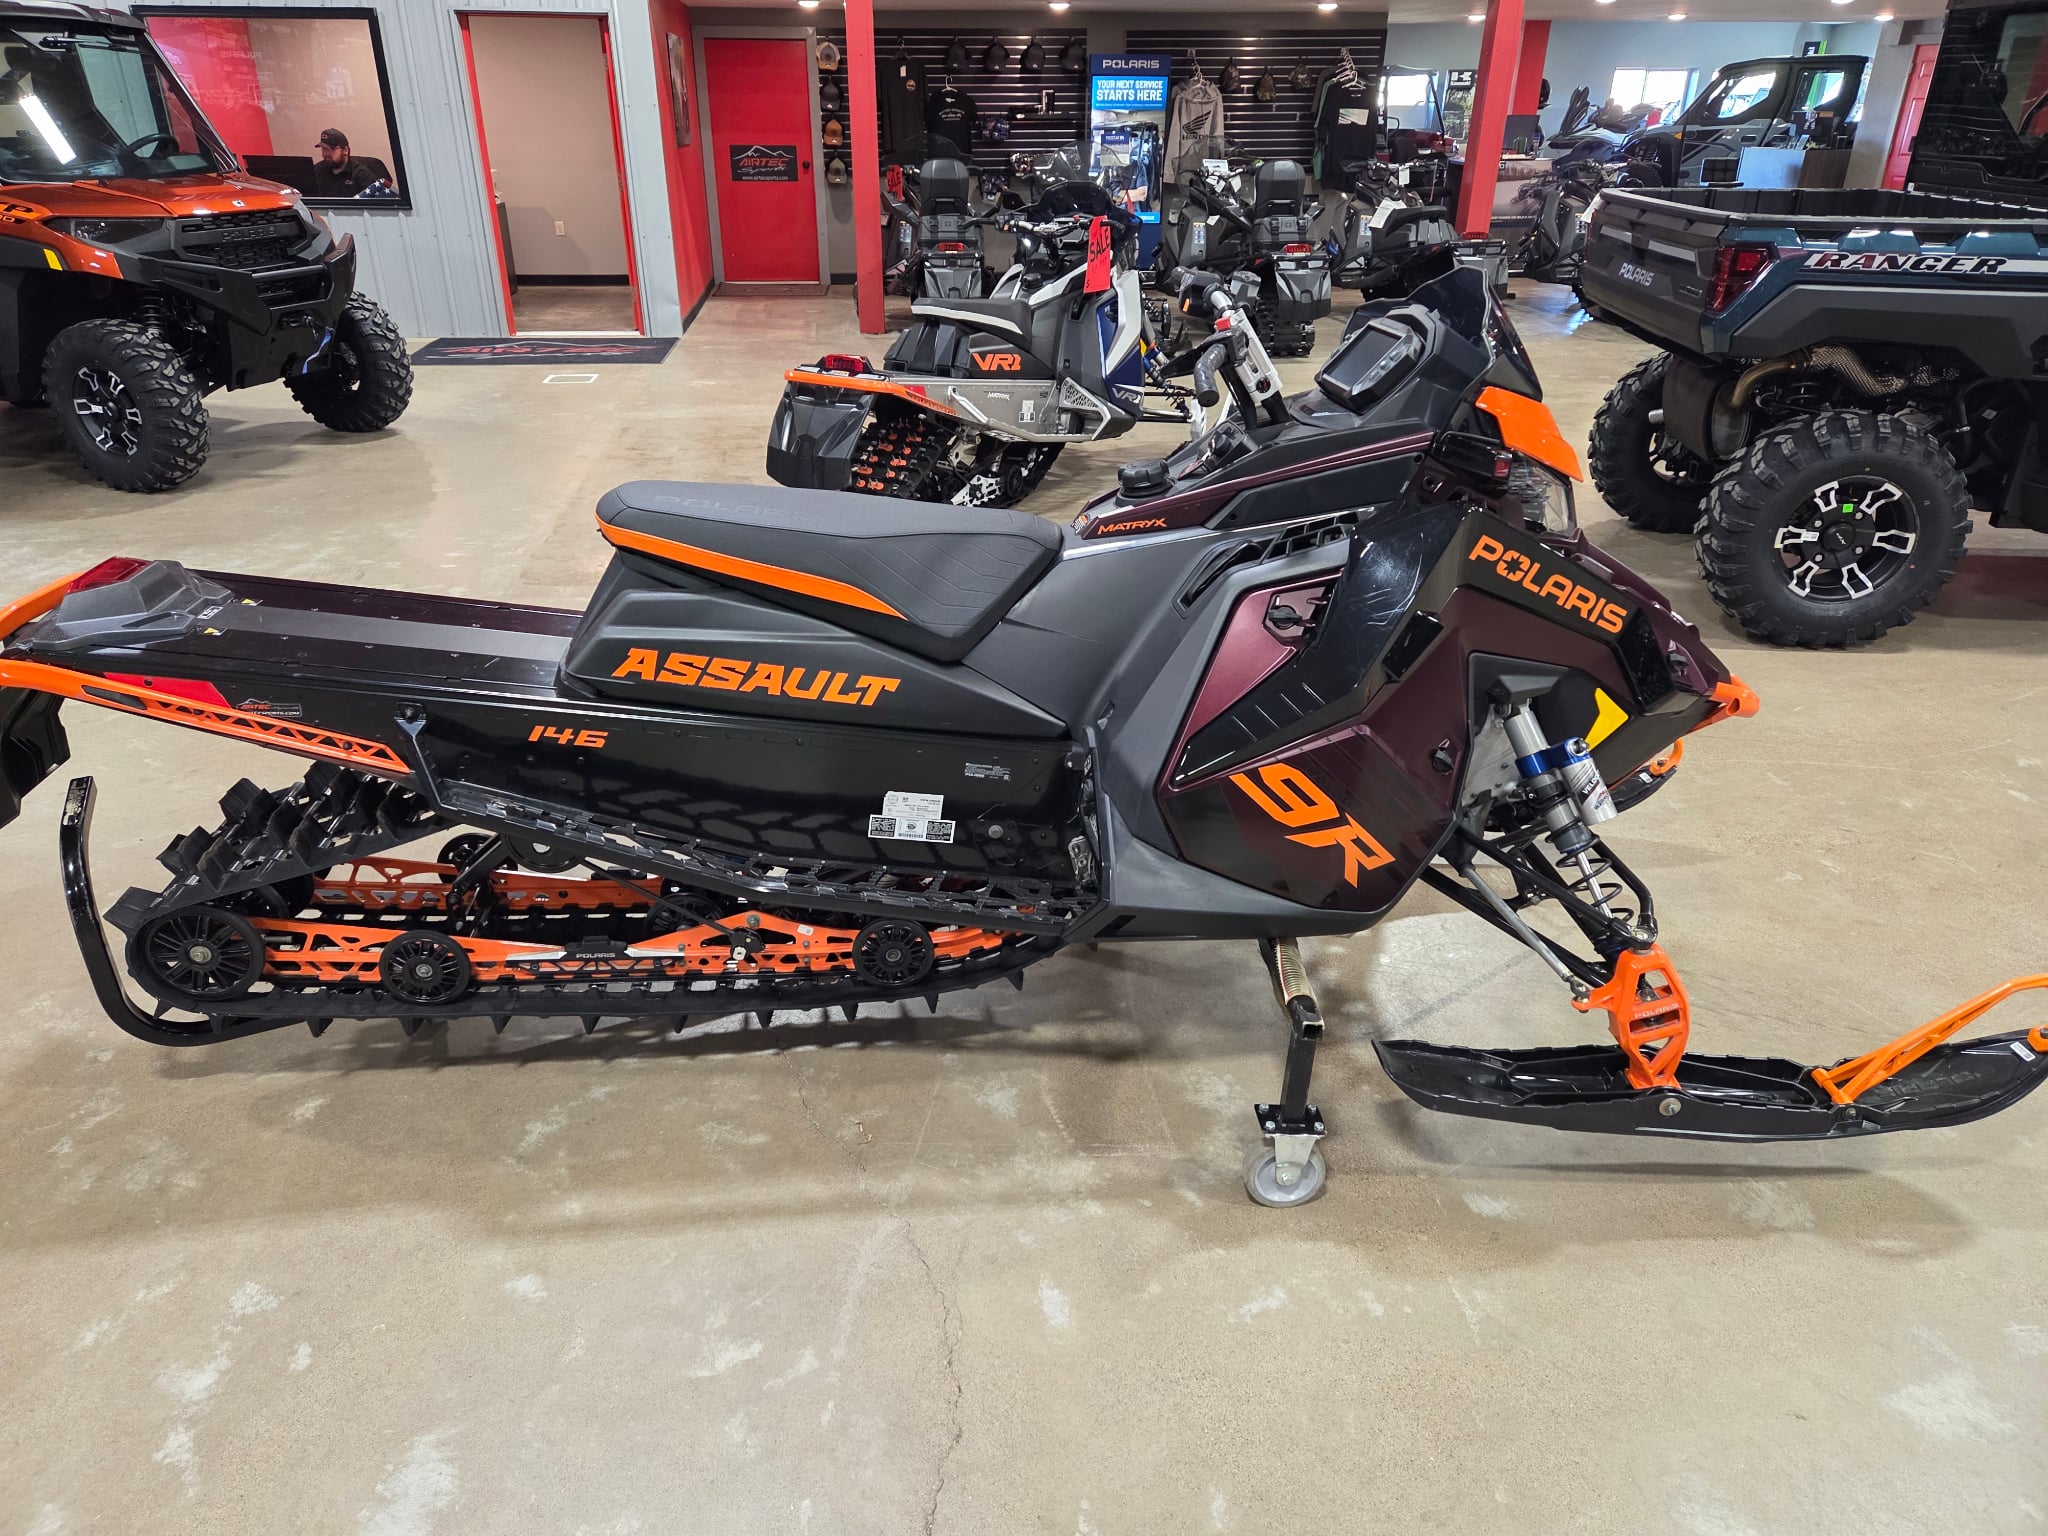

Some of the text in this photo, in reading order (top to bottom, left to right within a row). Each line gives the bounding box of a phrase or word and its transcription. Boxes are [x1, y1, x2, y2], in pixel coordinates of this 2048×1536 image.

[1102, 59, 1160, 69] POLARIS
[1097, 80, 1164, 89] YOUR NEXT SERVICE
[1096, 89, 1163, 101] STARTS HERE
[739, 158, 789, 167] AIRTEC
[1089, 227, 1110, 263] SALE
[1813, 251, 2008, 274] RANGER
[1618, 262, 1655, 286] POLARIS
[971, 352, 1022, 371] VR1
[1112, 387, 1142, 404] VR1
[1097, 517, 1168, 535] MATRYX
[1468, 534, 1628, 634] POLARIS
[611, 647, 901, 706] ASSAULT
[528, 725, 609, 748] 146
[1228, 762, 1396, 889] 9R
[1634, 1002, 1680, 1019] POLARIS
